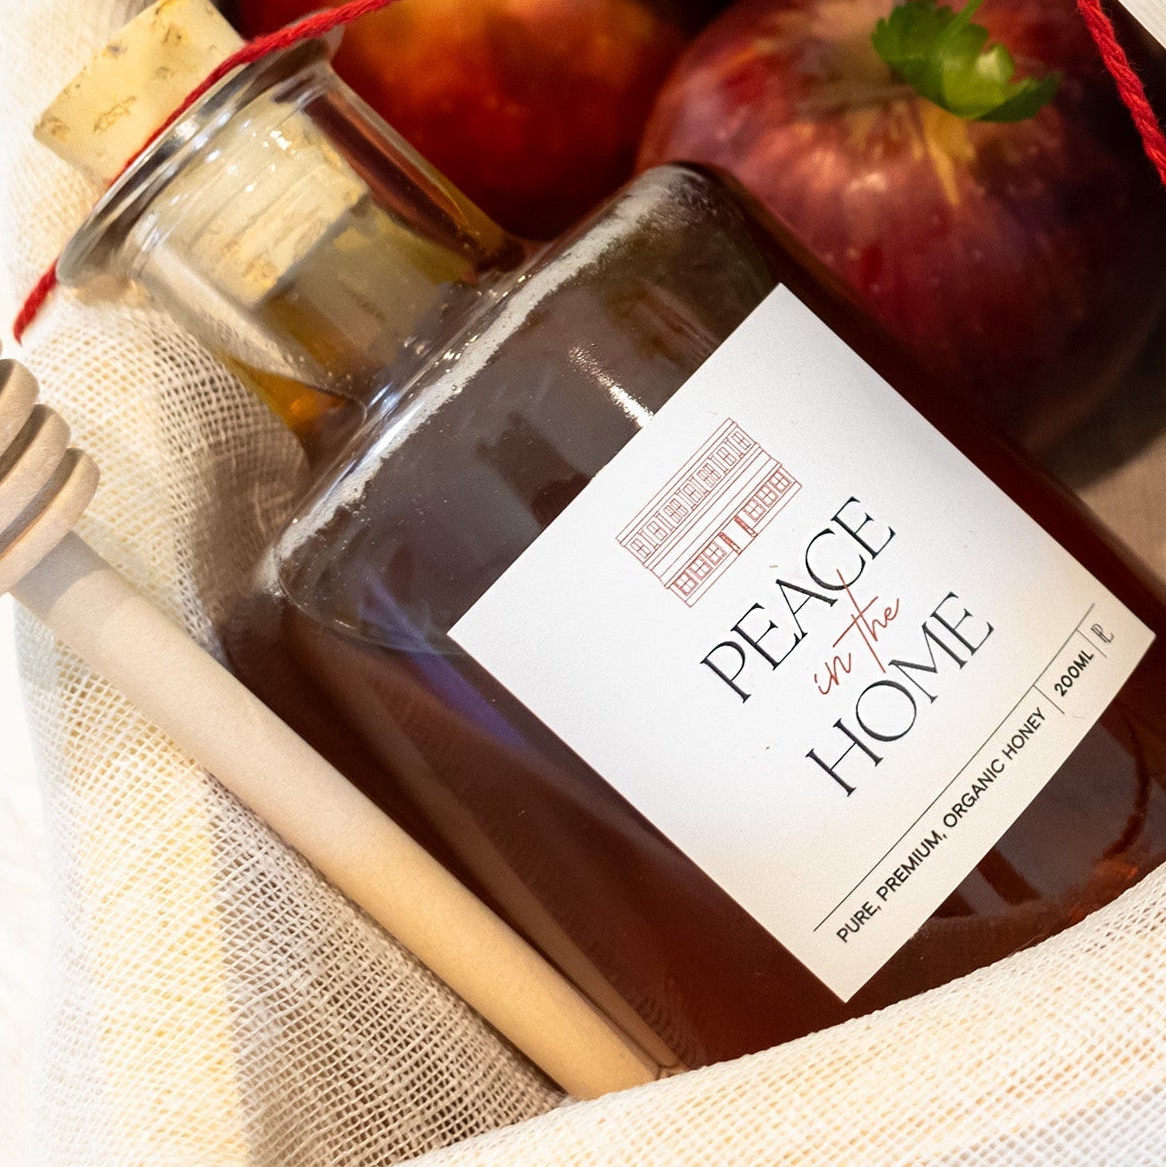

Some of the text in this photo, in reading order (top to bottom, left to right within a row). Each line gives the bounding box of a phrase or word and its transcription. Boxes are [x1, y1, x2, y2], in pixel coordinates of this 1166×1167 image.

[700, 496, 896, 703] PEACE
[805, 591, 995, 797] HOME
[814, 569, 901, 695] in the
[836, 895, 882, 943] PURE,
[877, 830, 947, 900] PREMIUM,
[943, 759, 1005, 829] ORGANIC
[1002, 708, 1046, 760] HONEY
[1054, 649, 1094, 697] 200ML
